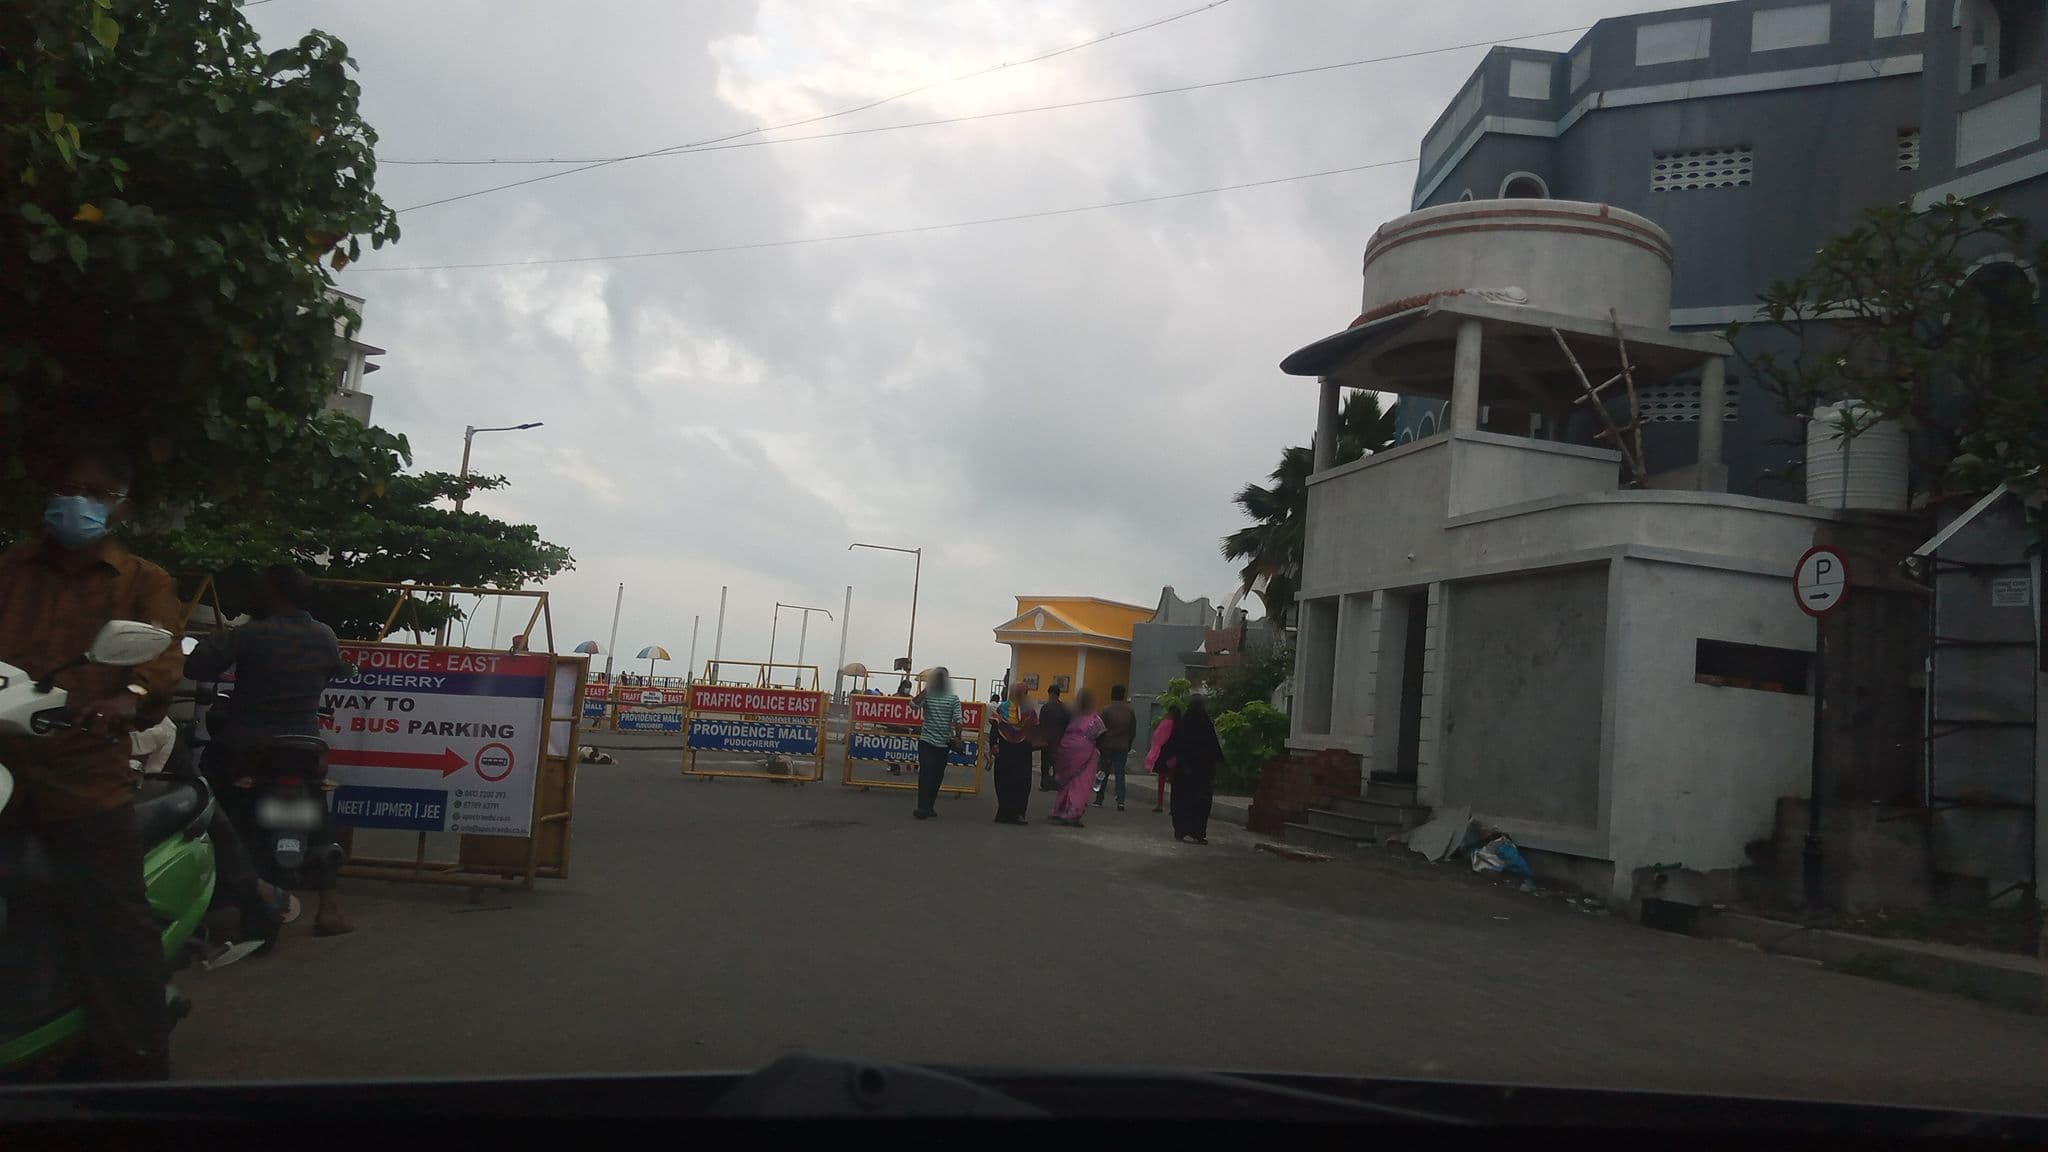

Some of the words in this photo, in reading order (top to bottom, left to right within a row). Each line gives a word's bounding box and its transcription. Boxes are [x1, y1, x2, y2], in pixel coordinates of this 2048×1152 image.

[1815, 559, 1831, 585] P
[357, 651, 430, 669] POLICE
[447, 654, 500, 673] EAST
[590, 687, 606, 696] EAST
[622, 692, 641, 702] TRAFF
[324, 694, 376, 710] WAY
[384, 697, 415, 712] TO
[696, 692, 742, 708] TRAFFIC
[745, 695, 786, 711] POLICE
[788, 697, 818, 713] EAST
[855, 701, 902, 719] TRAFFIC
[621, 713, 662, 722] PROVIDENCE
[662, 714, 680, 722] MALL
[351, 716, 400, 733] BUS
[407, 720, 515, 739] PARKING
[693, 723, 775, 739] PROVIDENCE
[779, 727, 813, 742] MALL
[724, 738, 780, 749] PUDUCHERRY
[855, 735, 919, 752] PROVIDEN
[885, 751, 919, 761] PUDUCH
[337, 800, 364, 816] NEET
[371, 801, 413, 818] JIPMER
[421, 803, 440, 820] JEE
